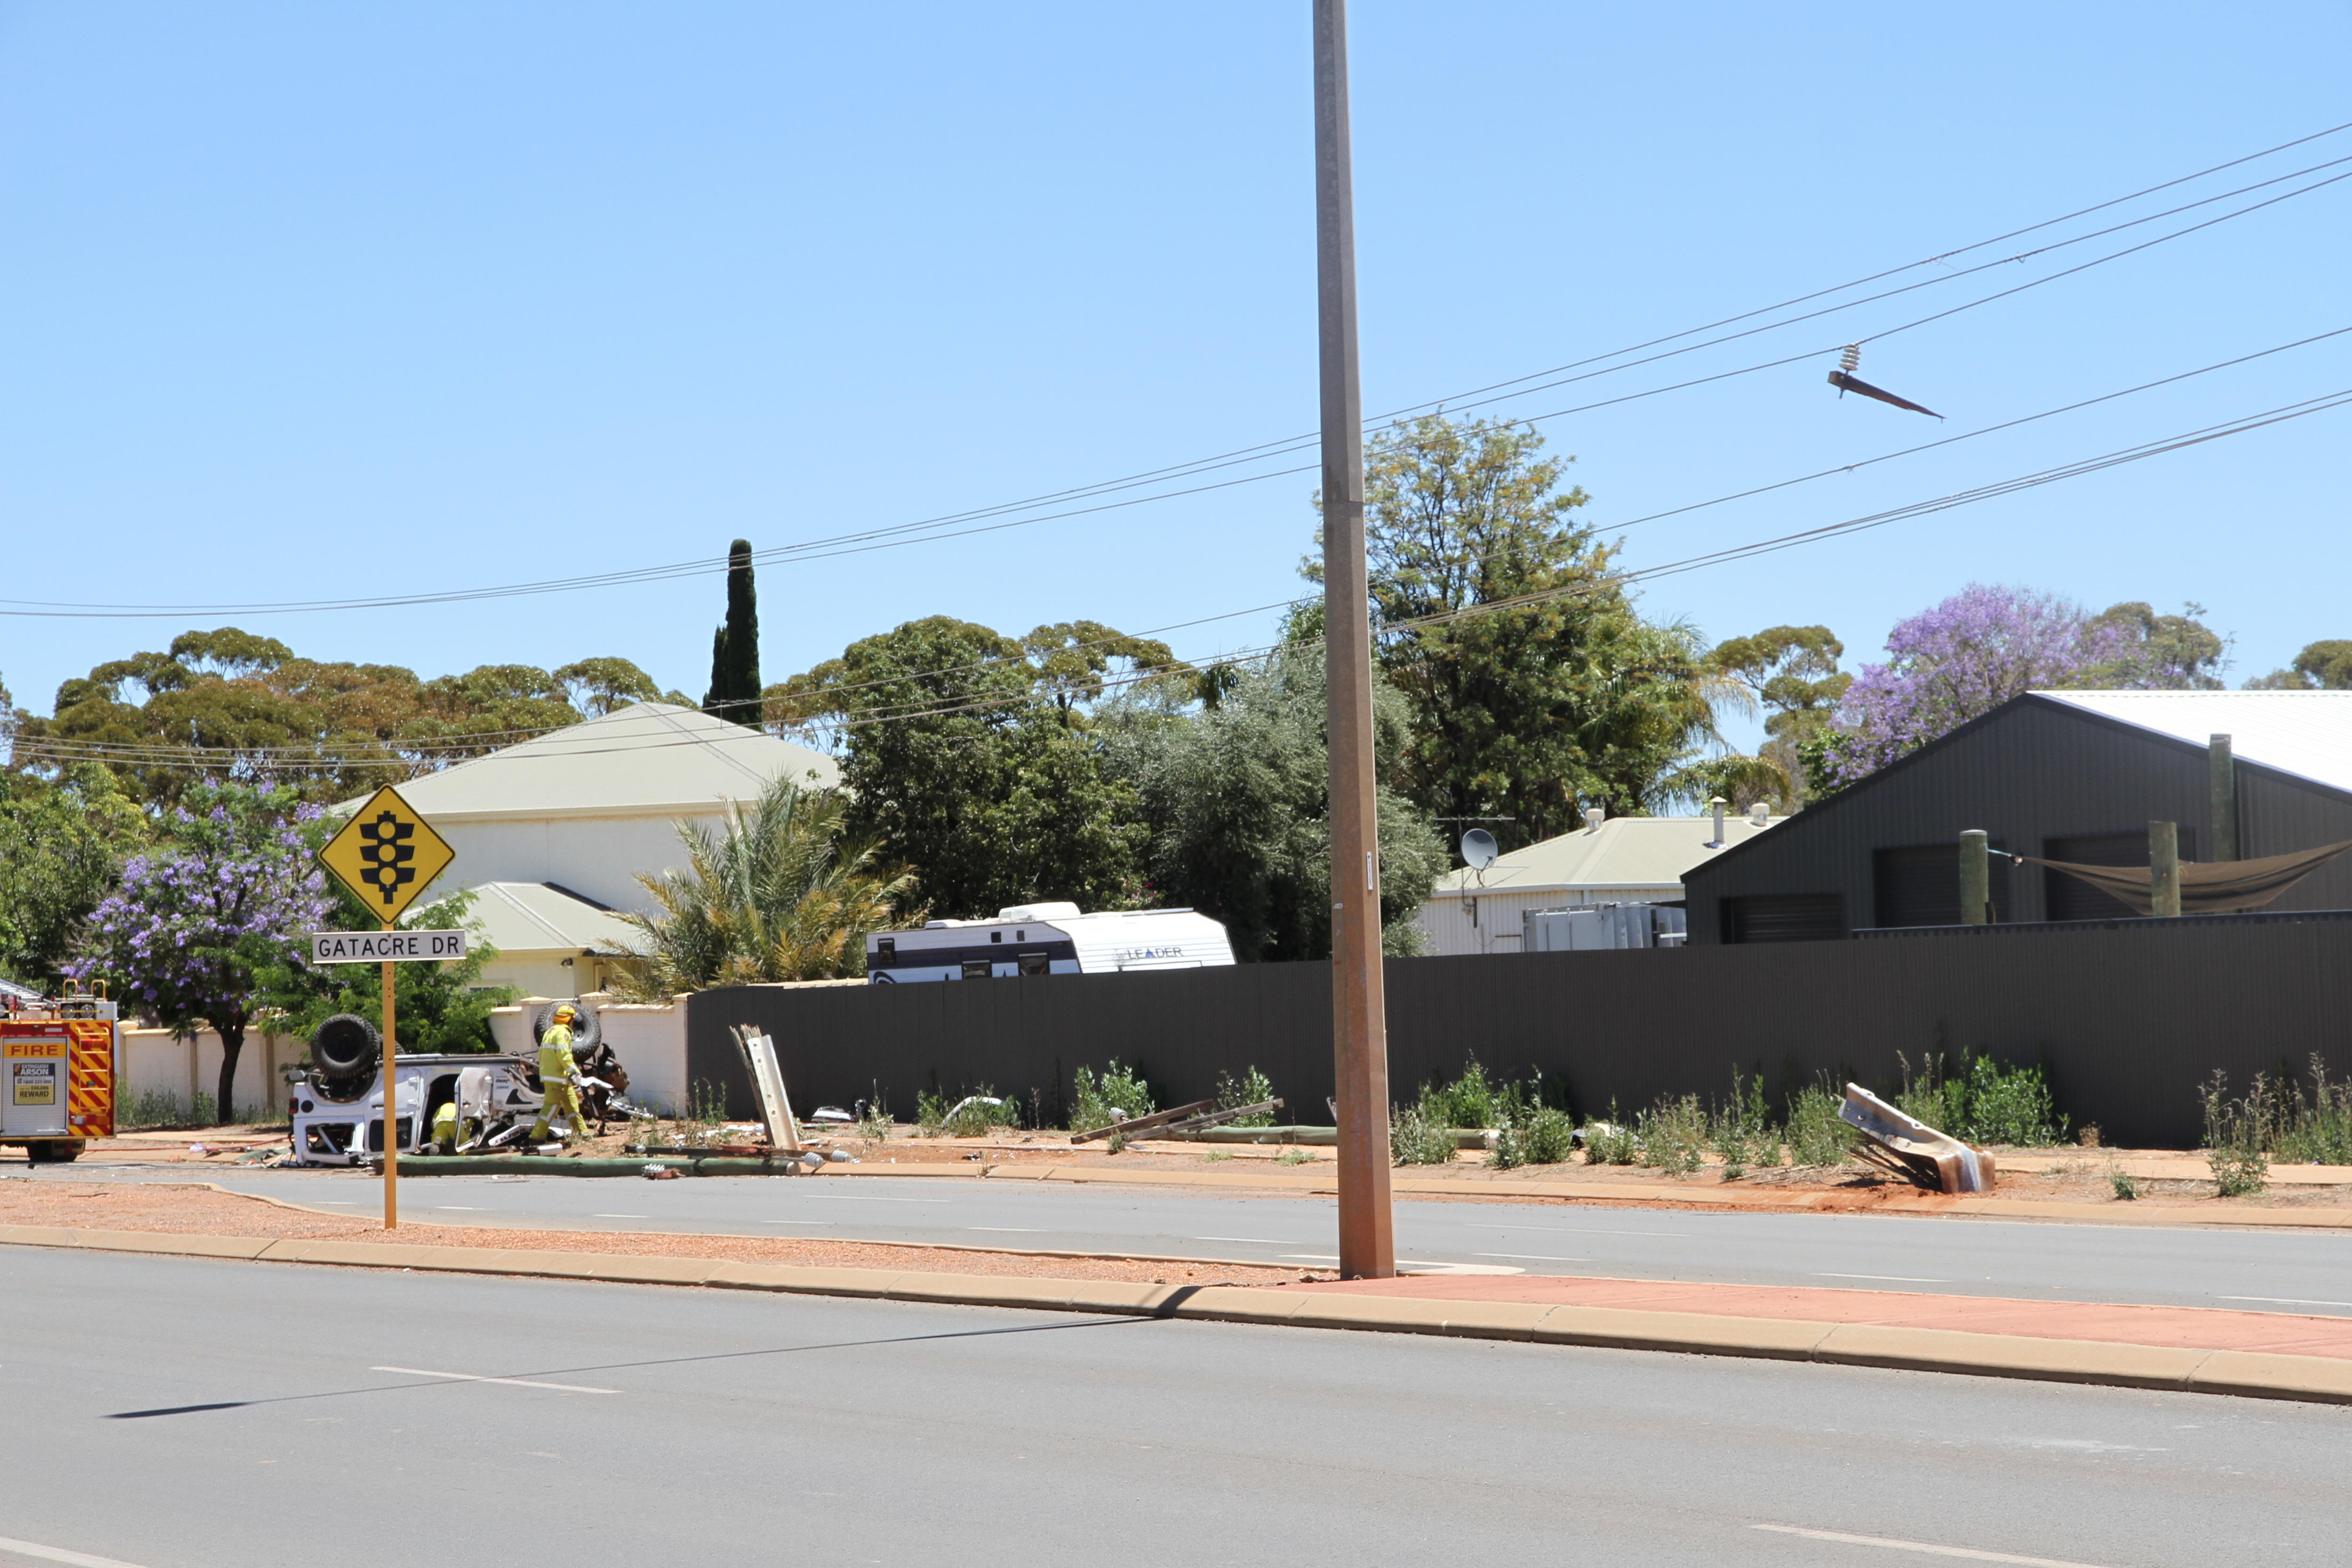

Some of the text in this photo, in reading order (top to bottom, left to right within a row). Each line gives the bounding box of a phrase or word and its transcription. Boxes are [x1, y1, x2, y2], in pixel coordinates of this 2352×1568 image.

[318, 937, 459, 957] GATACRE DR
[1127, 947, 1184, 960] LEADER
[11, 1045, 58, 1056] FIRE
